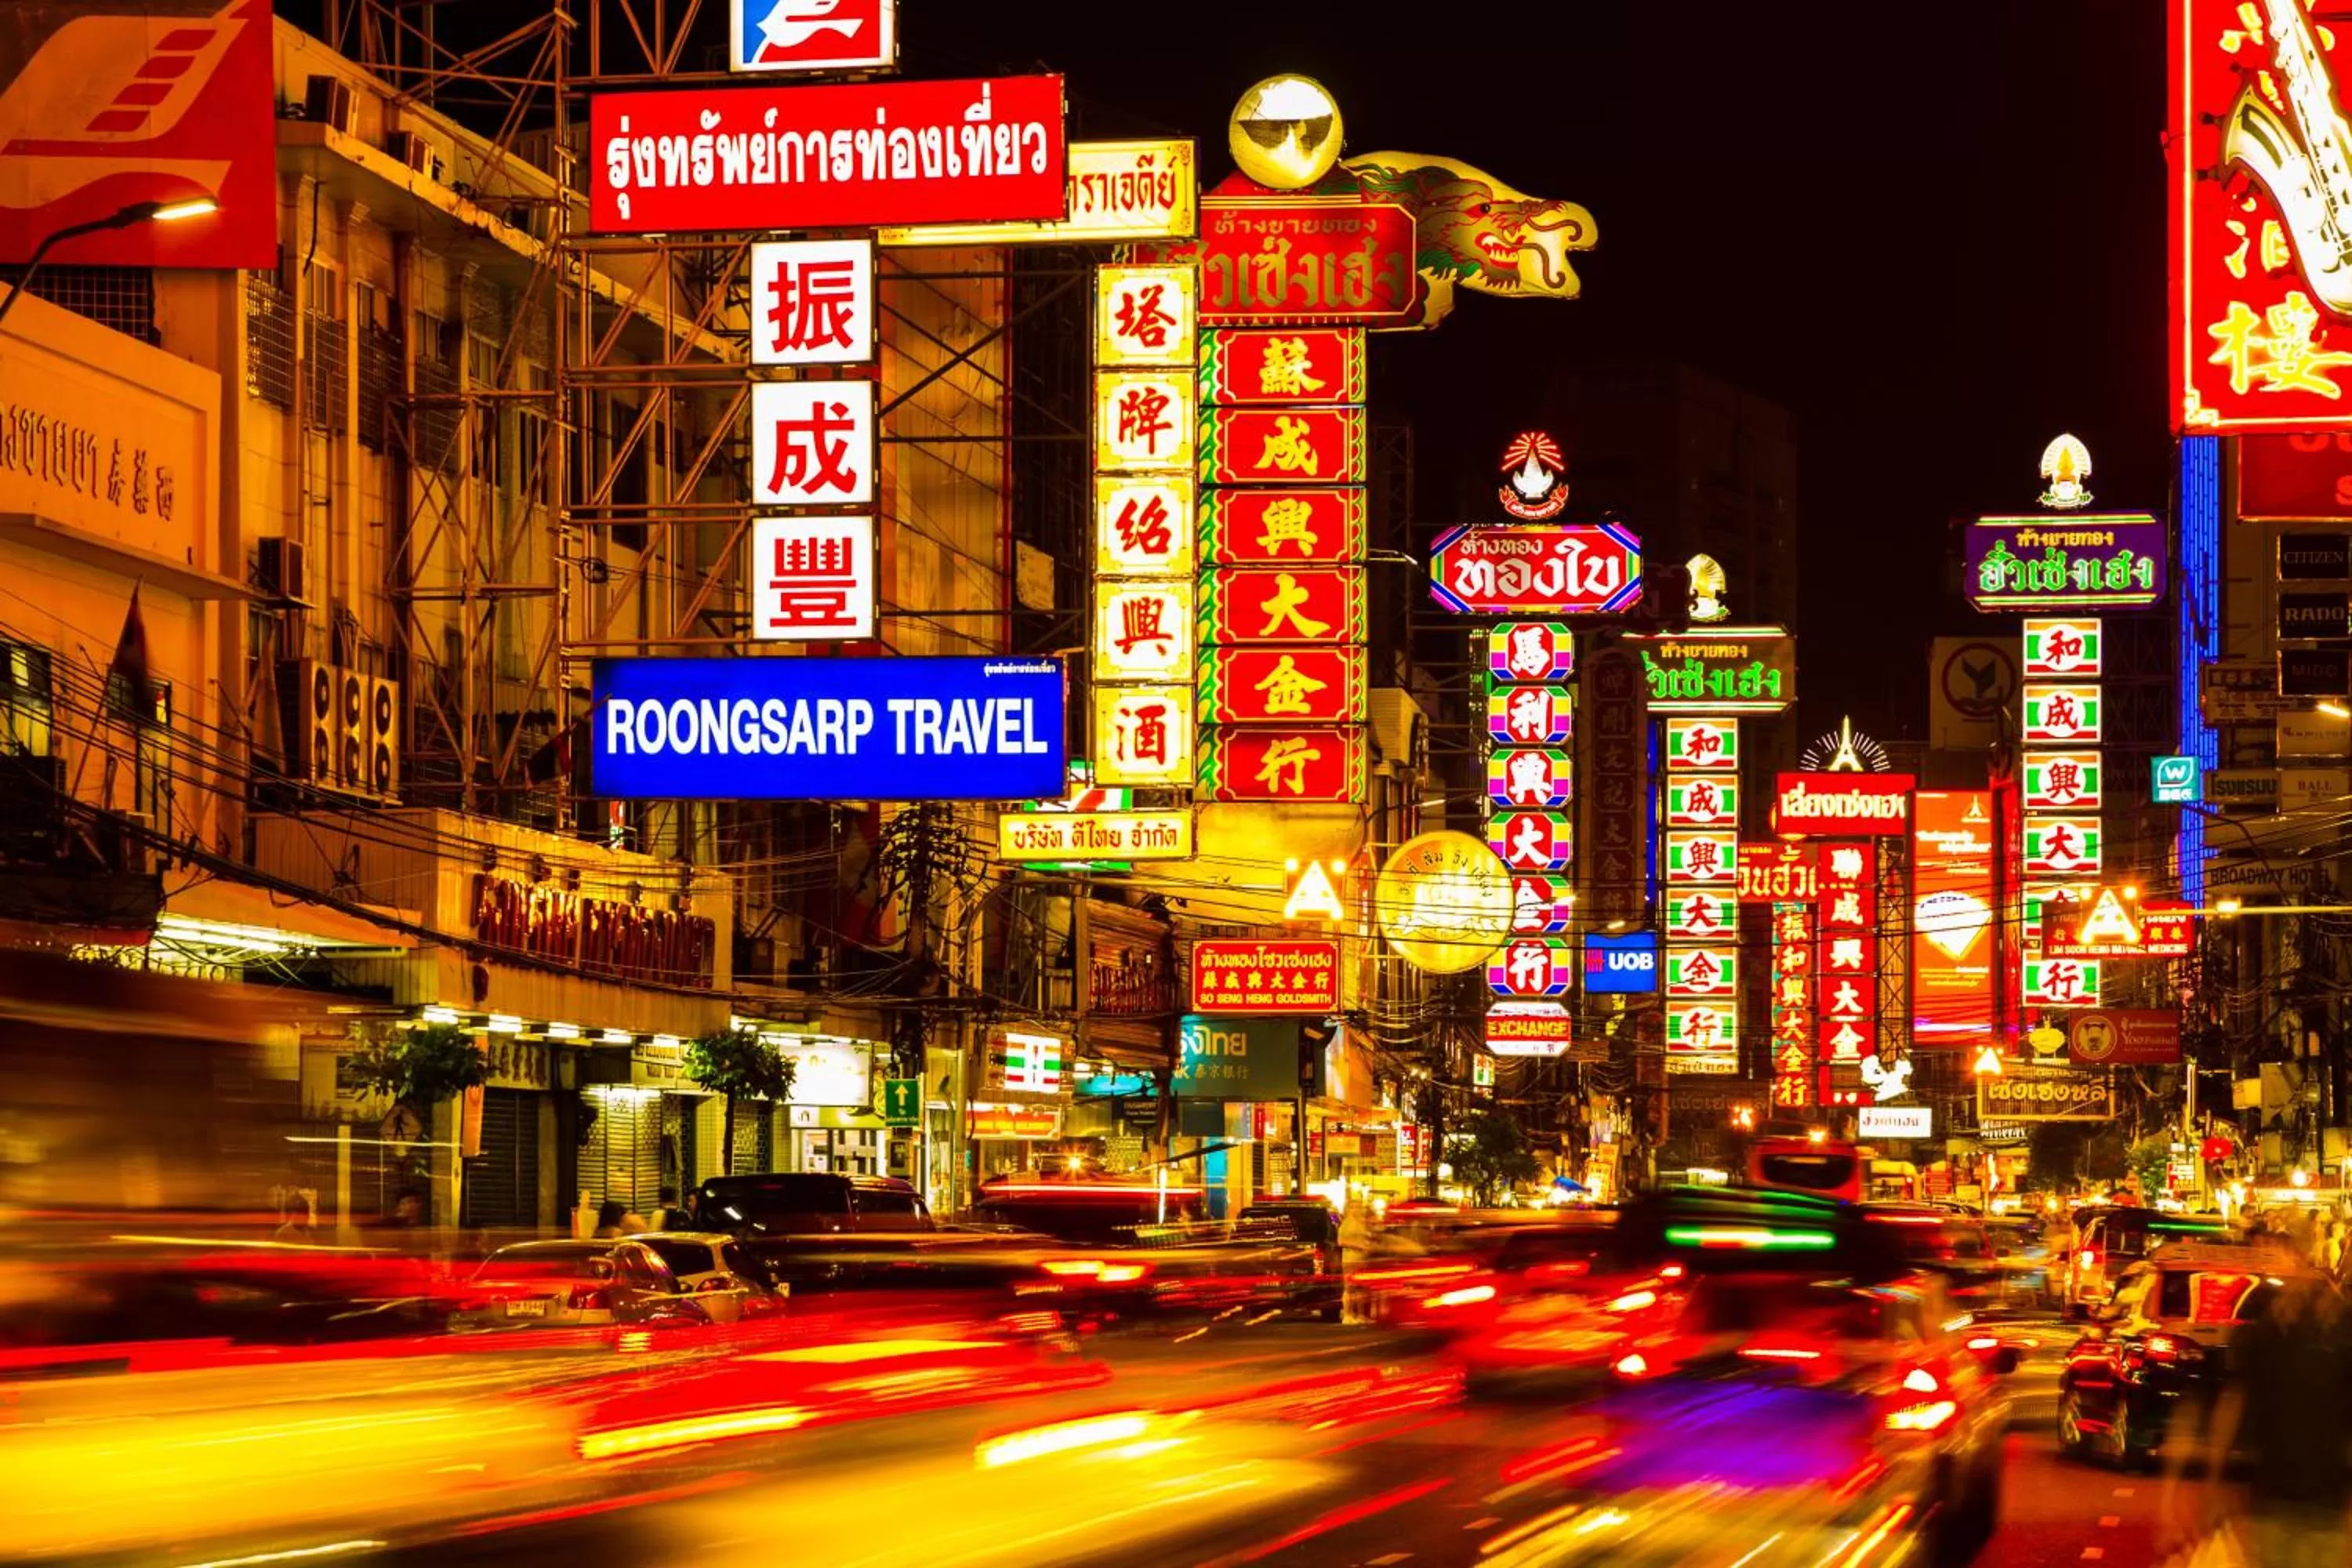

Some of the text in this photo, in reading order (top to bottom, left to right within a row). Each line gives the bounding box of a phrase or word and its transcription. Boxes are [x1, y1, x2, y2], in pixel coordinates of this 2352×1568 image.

[606, 82, 1047, 220] รุ่งทรัพย์การท่องเที่ยว
[0, 404, 99, 499] งขายยา
[768, 260, 857, 627] 振成豐
[1461, 531, 1543, 554] ห้างทอง
[2284, 551, 2343, 564] CITIZEN
[1254, 337, 1330, 793] 蘇成興大金行
[2285, 608, 2345, 622] RADO
[607, 698, 1047, 755] ROONGSARP TRAVEL
[2043, 630, 2083, 1000] 和成興大行
[1609, 953, 1653, 971] UOB
[1217, 993, 1243, 1004] SENG
[1246, 993, 1272, 1004] HENG
[1276, 993, 1332, 1004] GOLDSMITH
[1487, 1021, 1568, 1036] EXCHANGE
